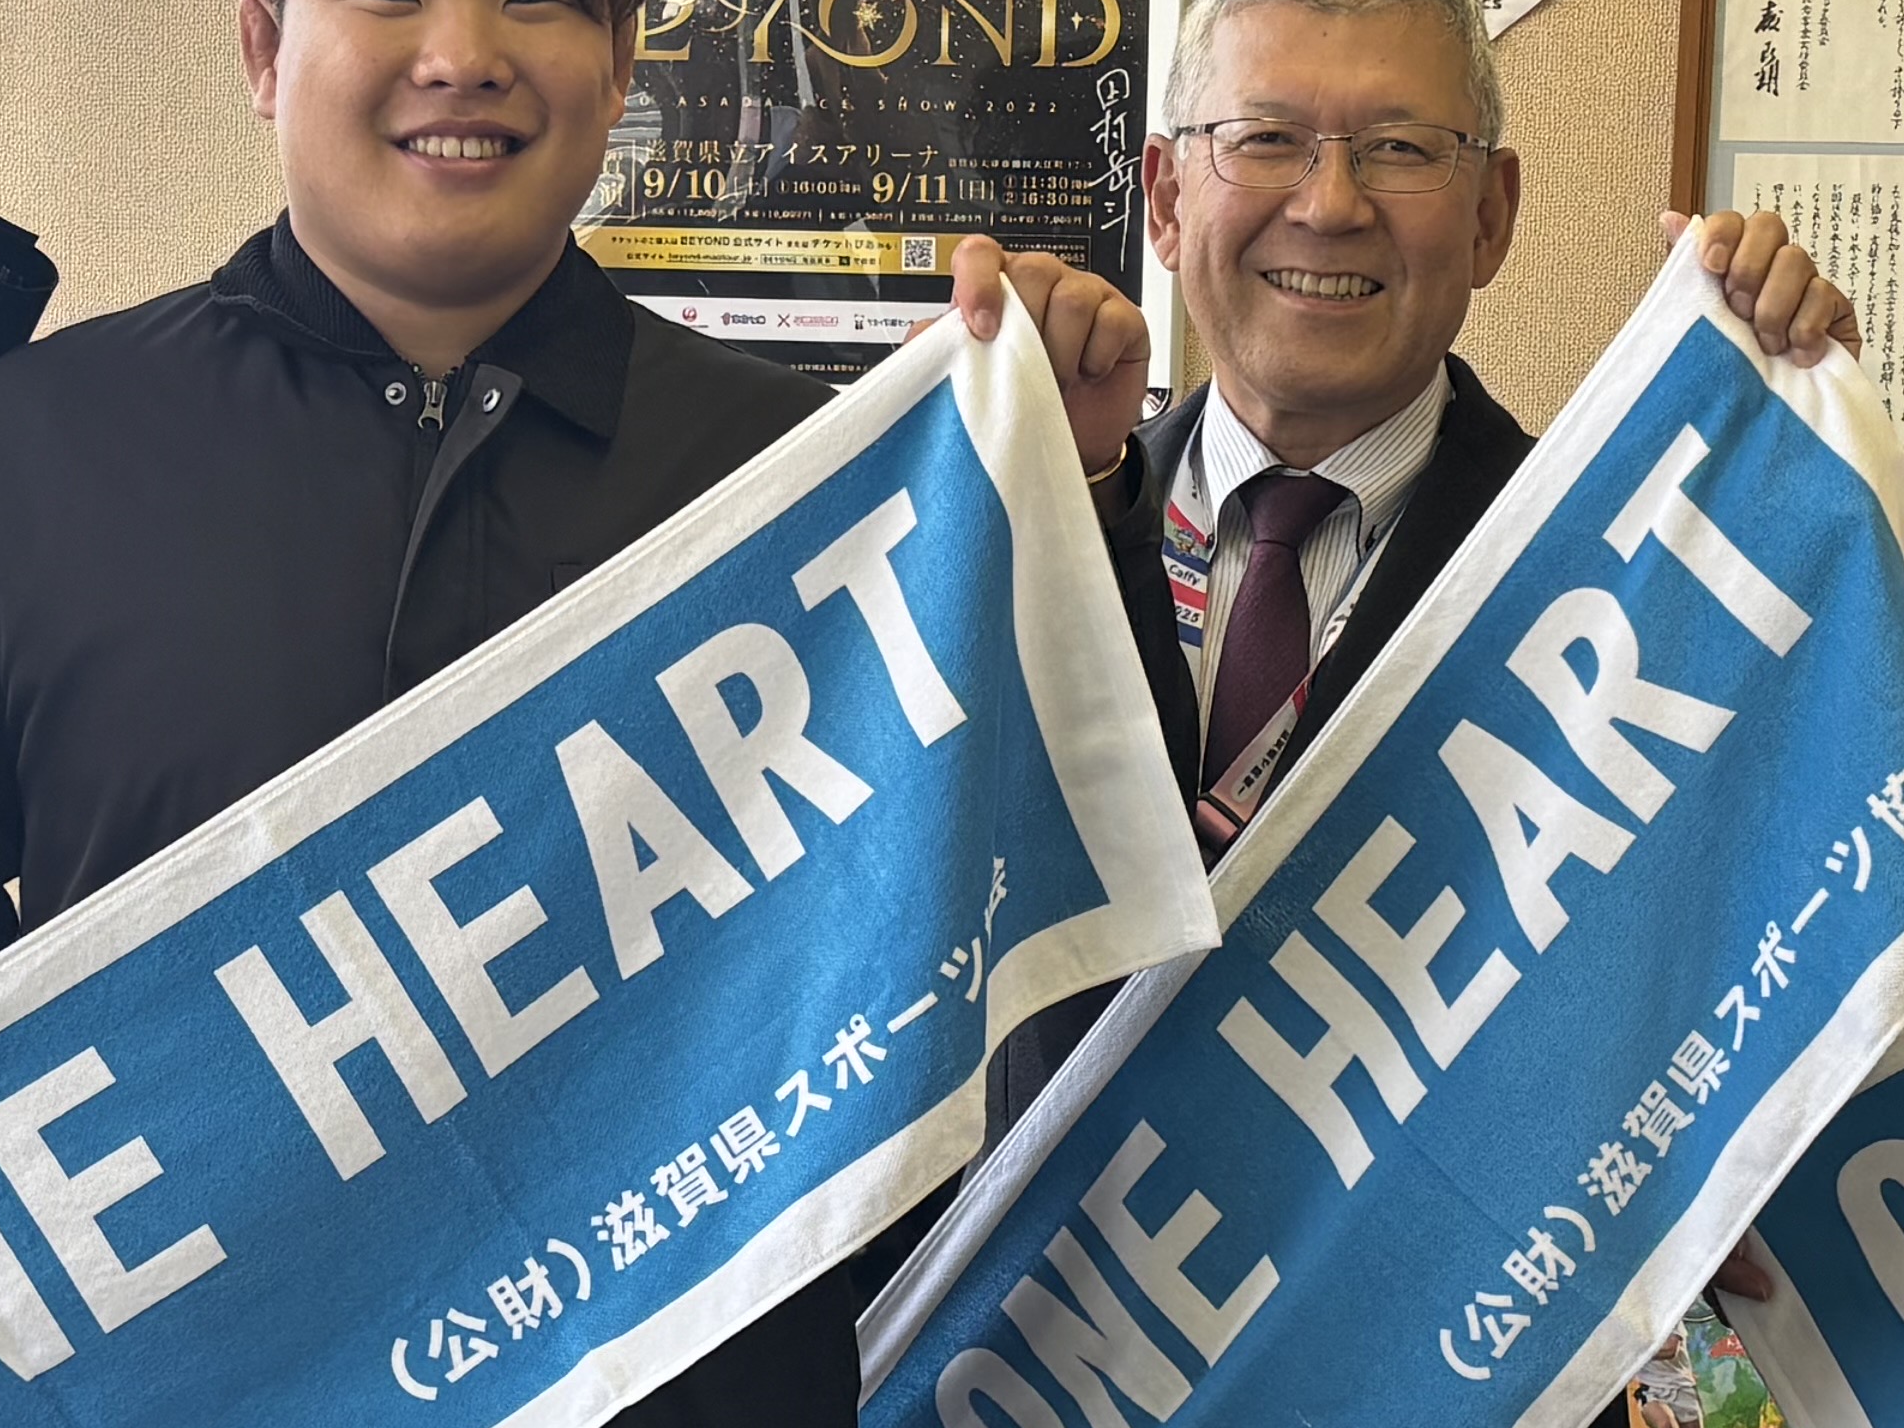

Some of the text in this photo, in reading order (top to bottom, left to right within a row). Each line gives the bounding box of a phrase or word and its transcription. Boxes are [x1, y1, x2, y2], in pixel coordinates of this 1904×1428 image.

[644, 139, 940, 168] 滋賀県立アイスアリーナ
[872, 171, 950, 204] 9/11
[214, 486, 969, 1182] HEART
[1215, 421, 1814, 1191] HEART
